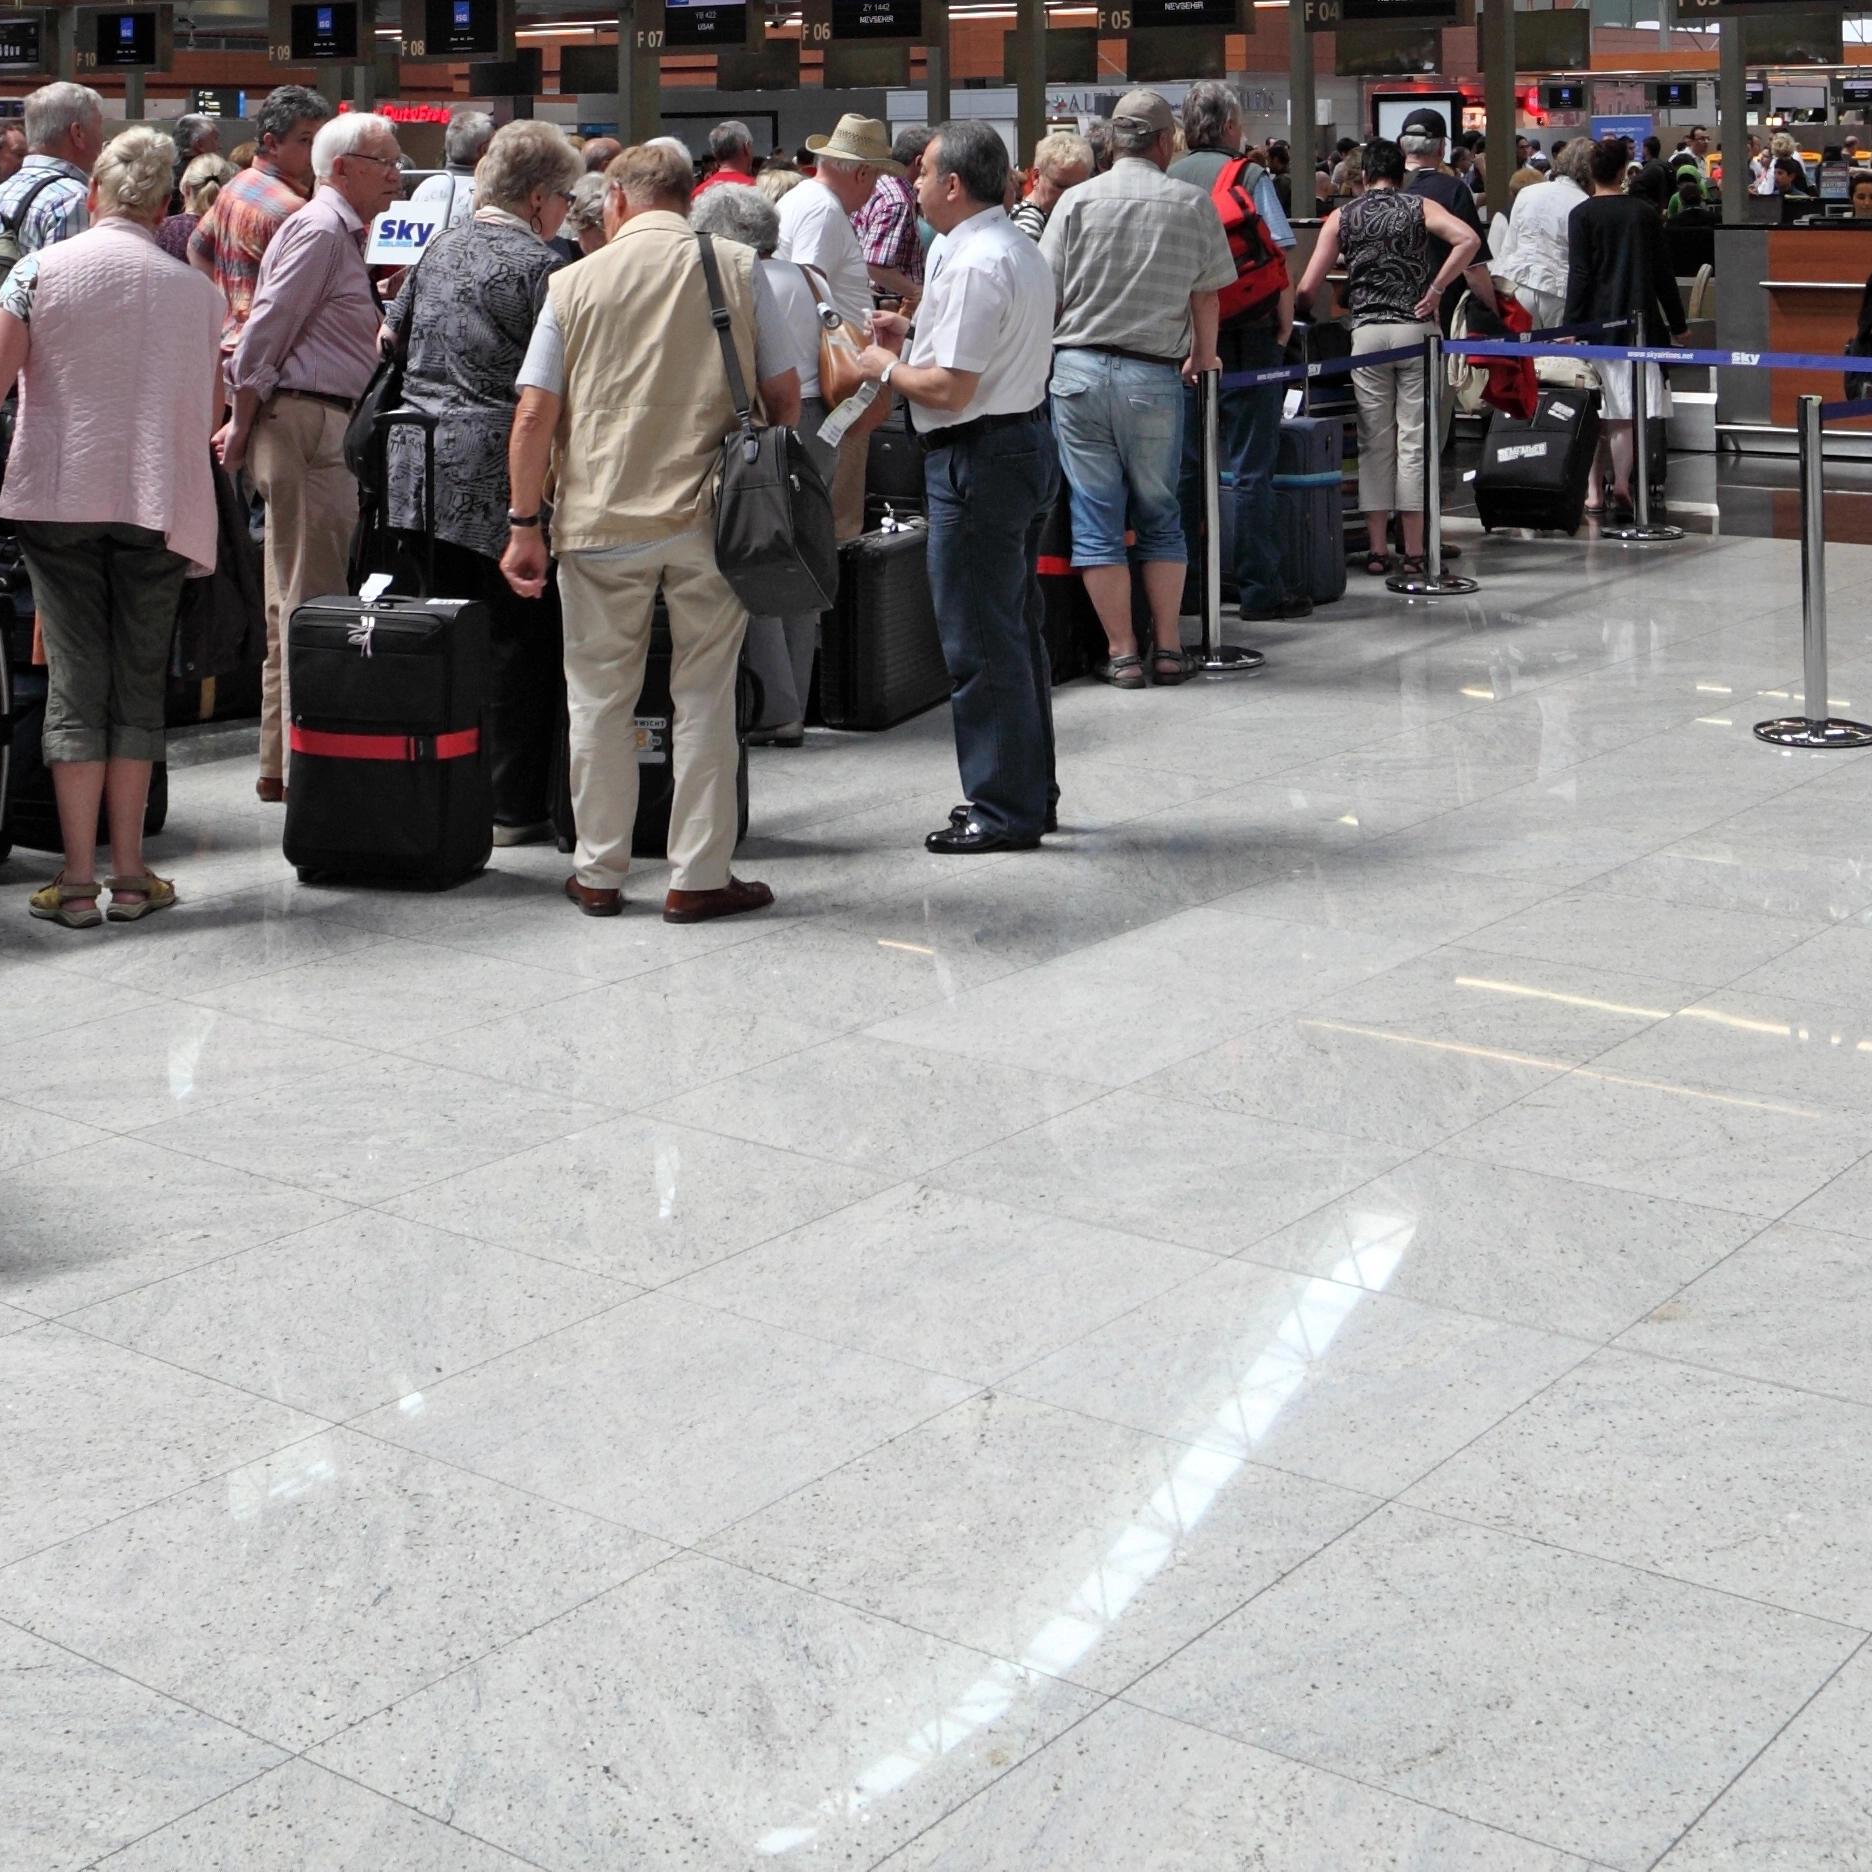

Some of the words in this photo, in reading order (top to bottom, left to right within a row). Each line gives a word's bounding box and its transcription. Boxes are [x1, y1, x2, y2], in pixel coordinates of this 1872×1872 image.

[1305, 2, 1314, 21] F
[1319, 1, 1339, 21] 04
[1099, 12, 1106, 30] F
[1111, 11, 1131, 29] 05
[637, 31, 644, 48] F
[648, 31, 663, 48] 07
[803, 24, 809, 40] F
[813, 23, 831, 40] 06
